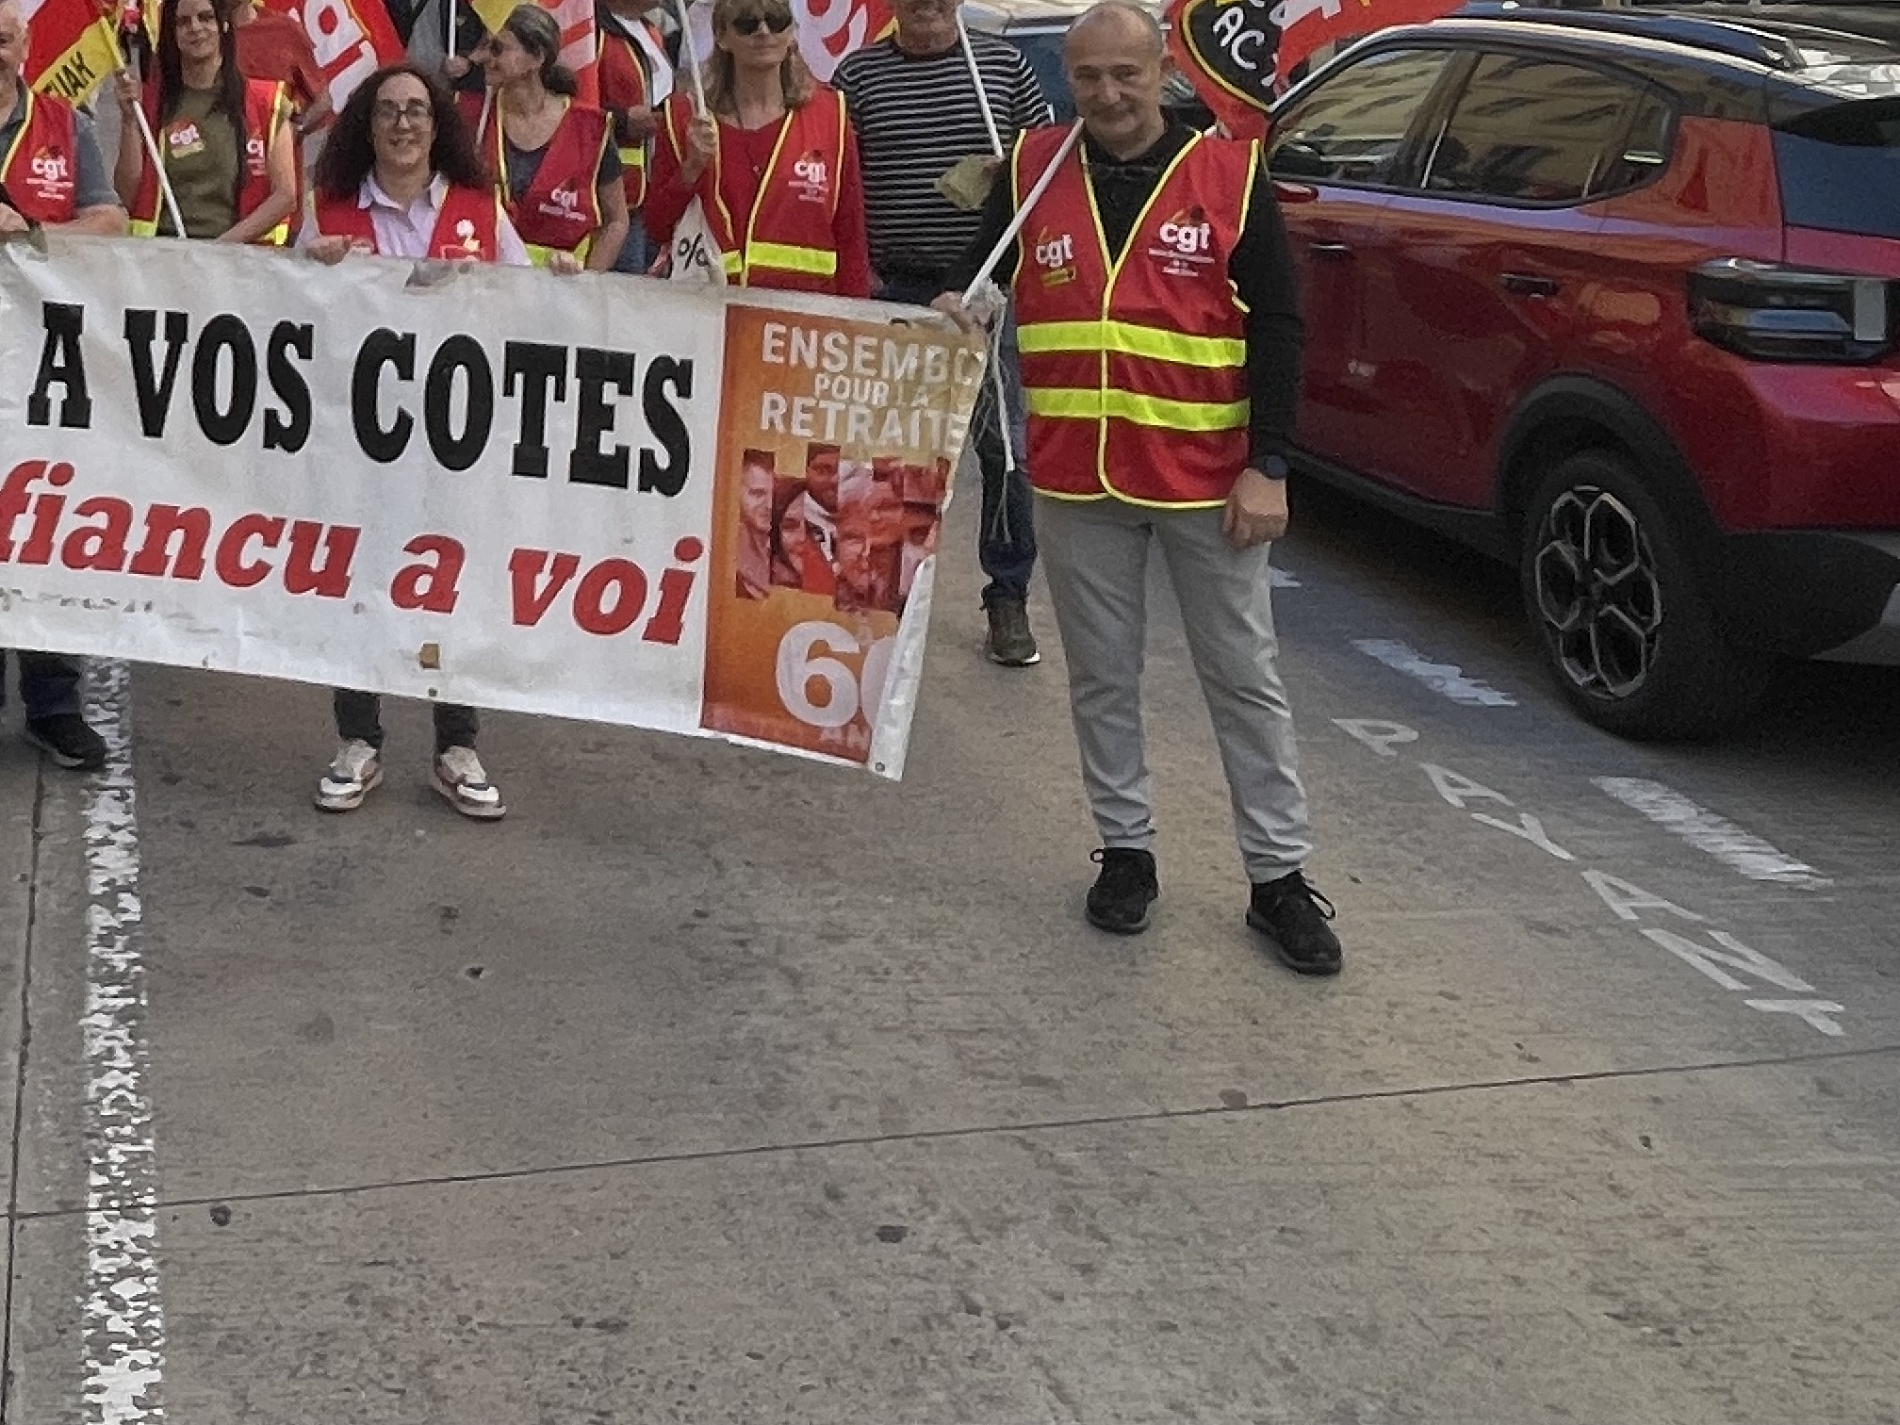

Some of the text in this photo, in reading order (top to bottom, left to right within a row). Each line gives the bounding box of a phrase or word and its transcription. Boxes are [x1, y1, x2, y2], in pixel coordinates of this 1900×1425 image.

[30, 154, 68, 181] cgt
[793, 160, 827, 183] cgt
[551, 187, 579, 208] cgt
[1035, 234, 1074, 268] cgt
[1159, 222, 1211, 253] cgt
[26, 301, 93, 429] A
[124, 307, 314, 453] VOS
[351, 326, 694, 497] COTES
[814, 373, 889, 408] POUR
[389, 533, 466, 615] a
[507, 536, 705, 646] voi
[1331, 718, 1845, 1037] PAYANT
